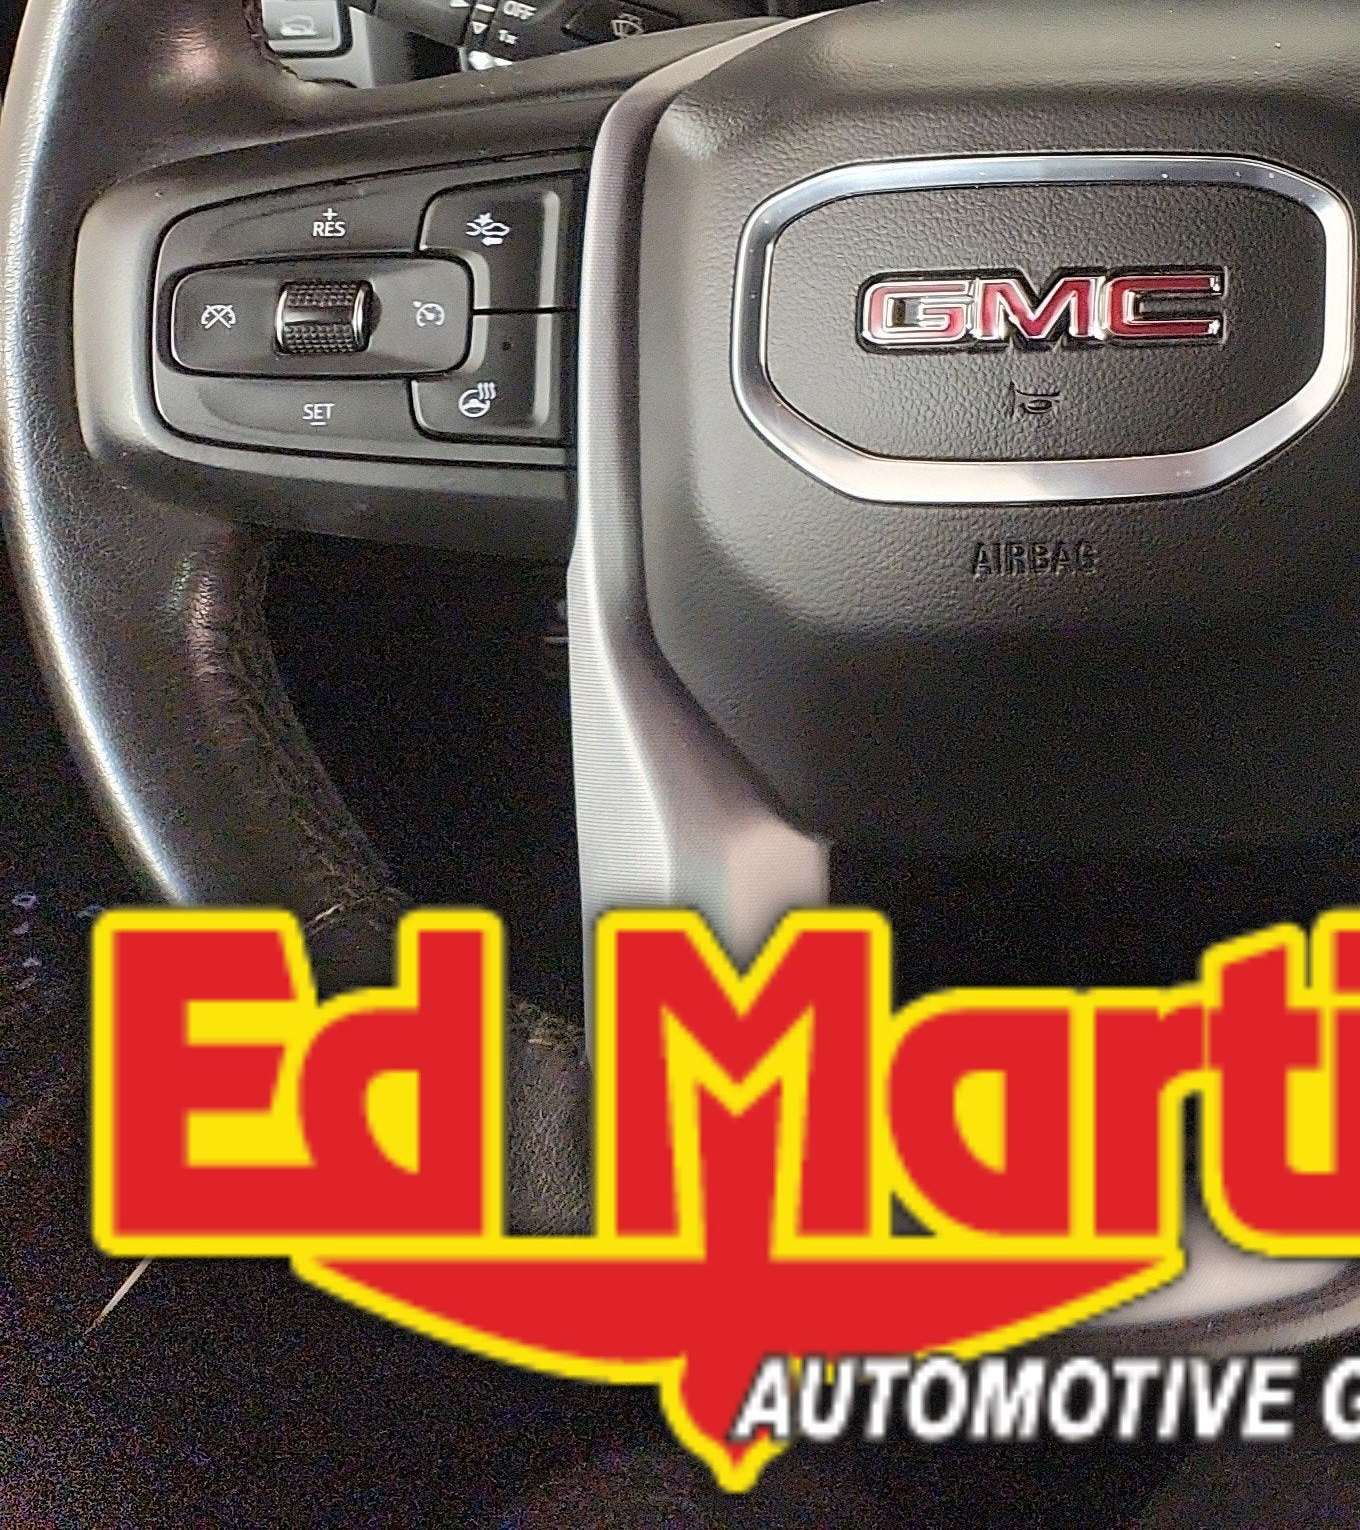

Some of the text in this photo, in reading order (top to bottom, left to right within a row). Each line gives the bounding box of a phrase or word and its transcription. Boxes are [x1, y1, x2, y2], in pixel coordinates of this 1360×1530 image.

[503, 0, 537, 20] OFF
[312, 220, 347, 238] RES
[860, 272, 1224, 346] GMC
[302, 402, 335, 421] SET
[971, 542, 1099, 579] AIRBAG
